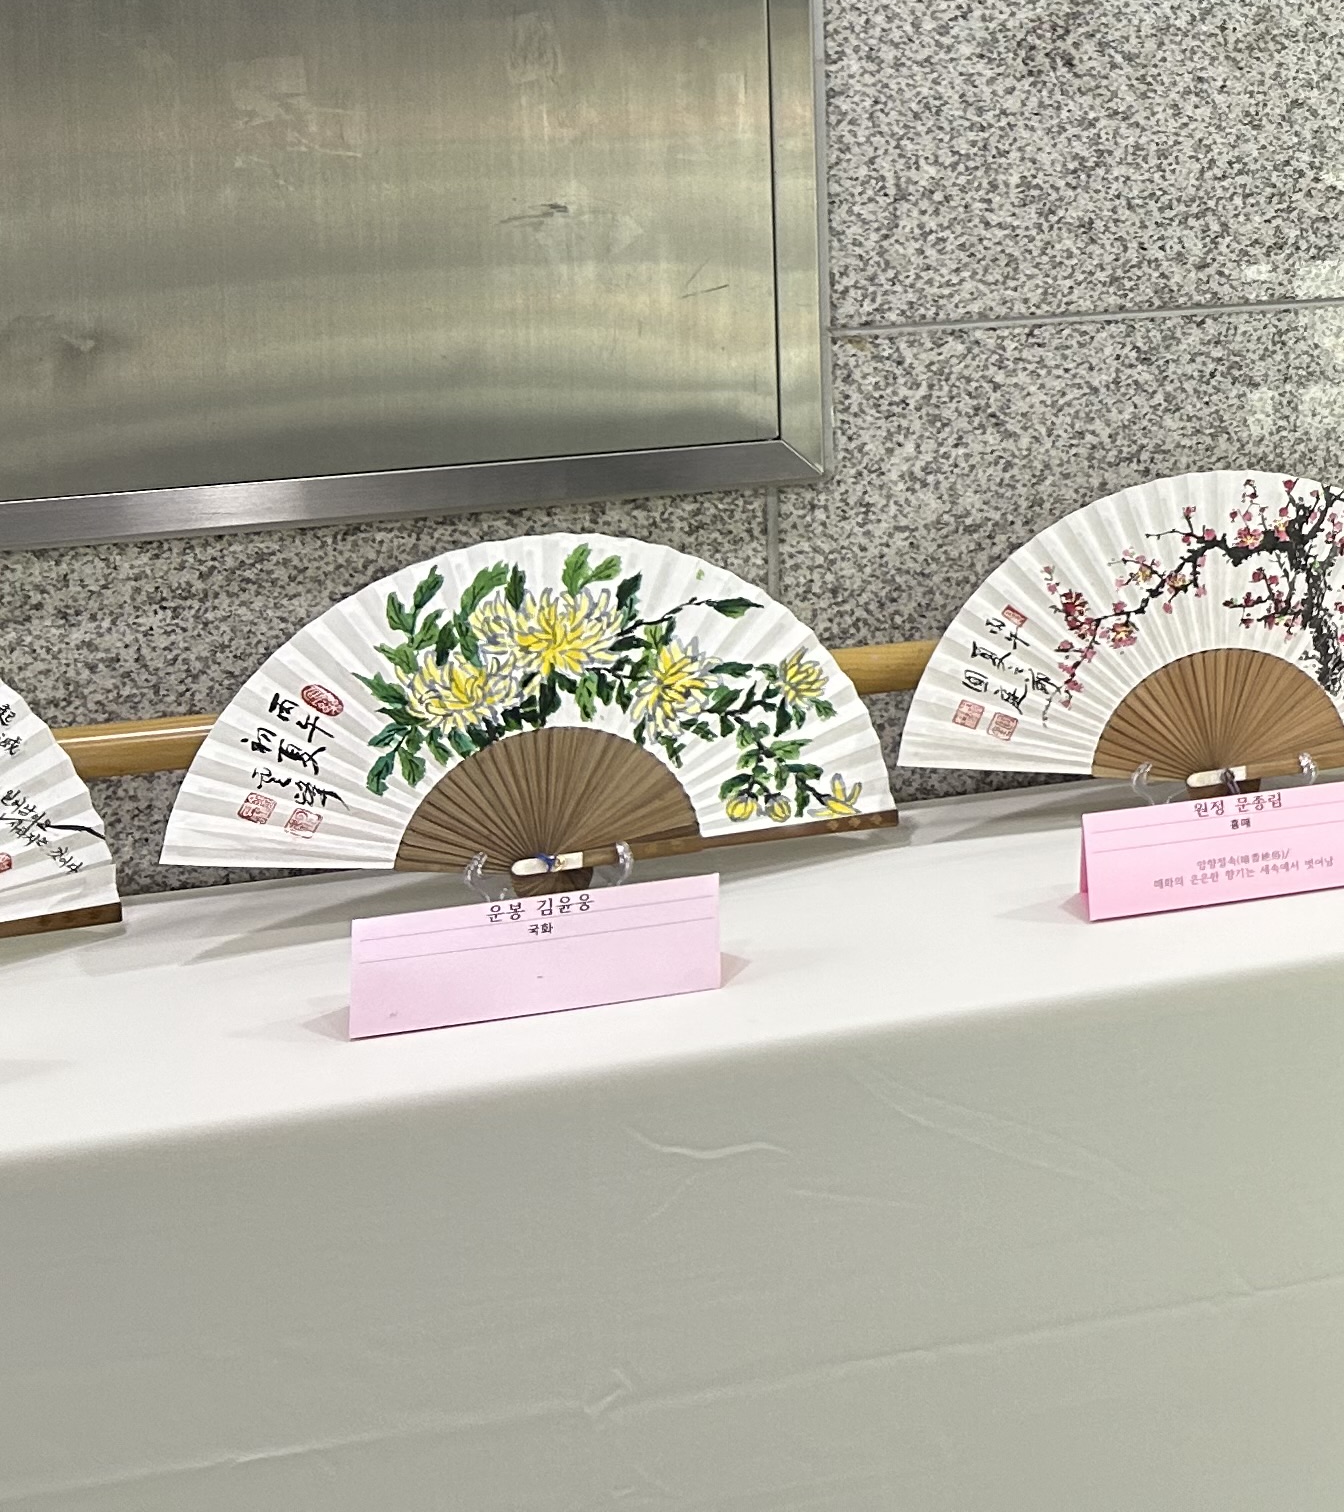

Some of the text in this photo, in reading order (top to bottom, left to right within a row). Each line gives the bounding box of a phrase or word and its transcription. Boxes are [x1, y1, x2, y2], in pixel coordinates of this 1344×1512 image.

[1194, 799, 1225, 817] 원정
[486, 893, 595, 923] 운봉 김윤웅
[528, 922, 554, 936] 국화
